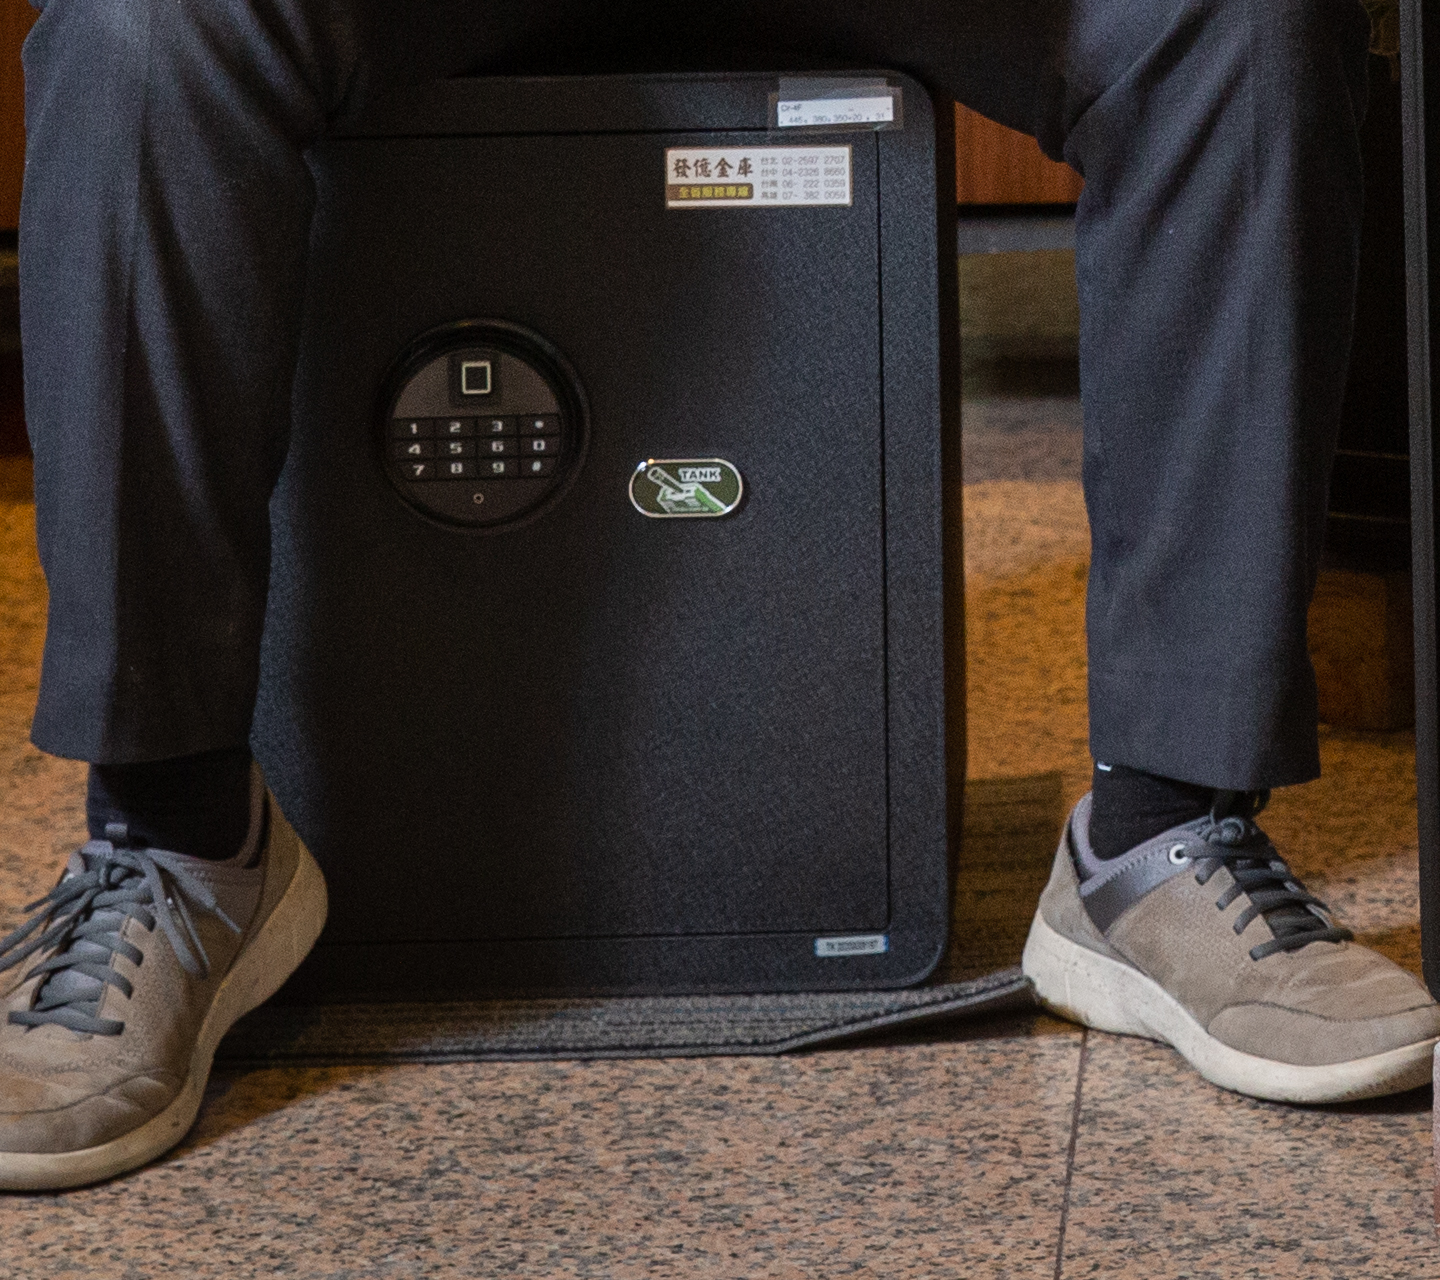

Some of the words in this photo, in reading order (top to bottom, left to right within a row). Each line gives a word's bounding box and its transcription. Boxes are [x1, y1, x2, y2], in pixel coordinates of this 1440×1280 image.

[672, 156, 754, 178] 發億金庫
[449, 421, 461, 433] 2
[491, 420, 503, 432] 3
[408, 443, 421, 455] 4
[449, 442, 462, 454] 5
[491, 441, 504, 453] 6
[533, 439, 545, 451] 0
[413, 464, 425, 476] 7
[450, 462, 463, 474] 8
[492, 461, 504, 474] 9
[679, 467, 722, 482] TANK
